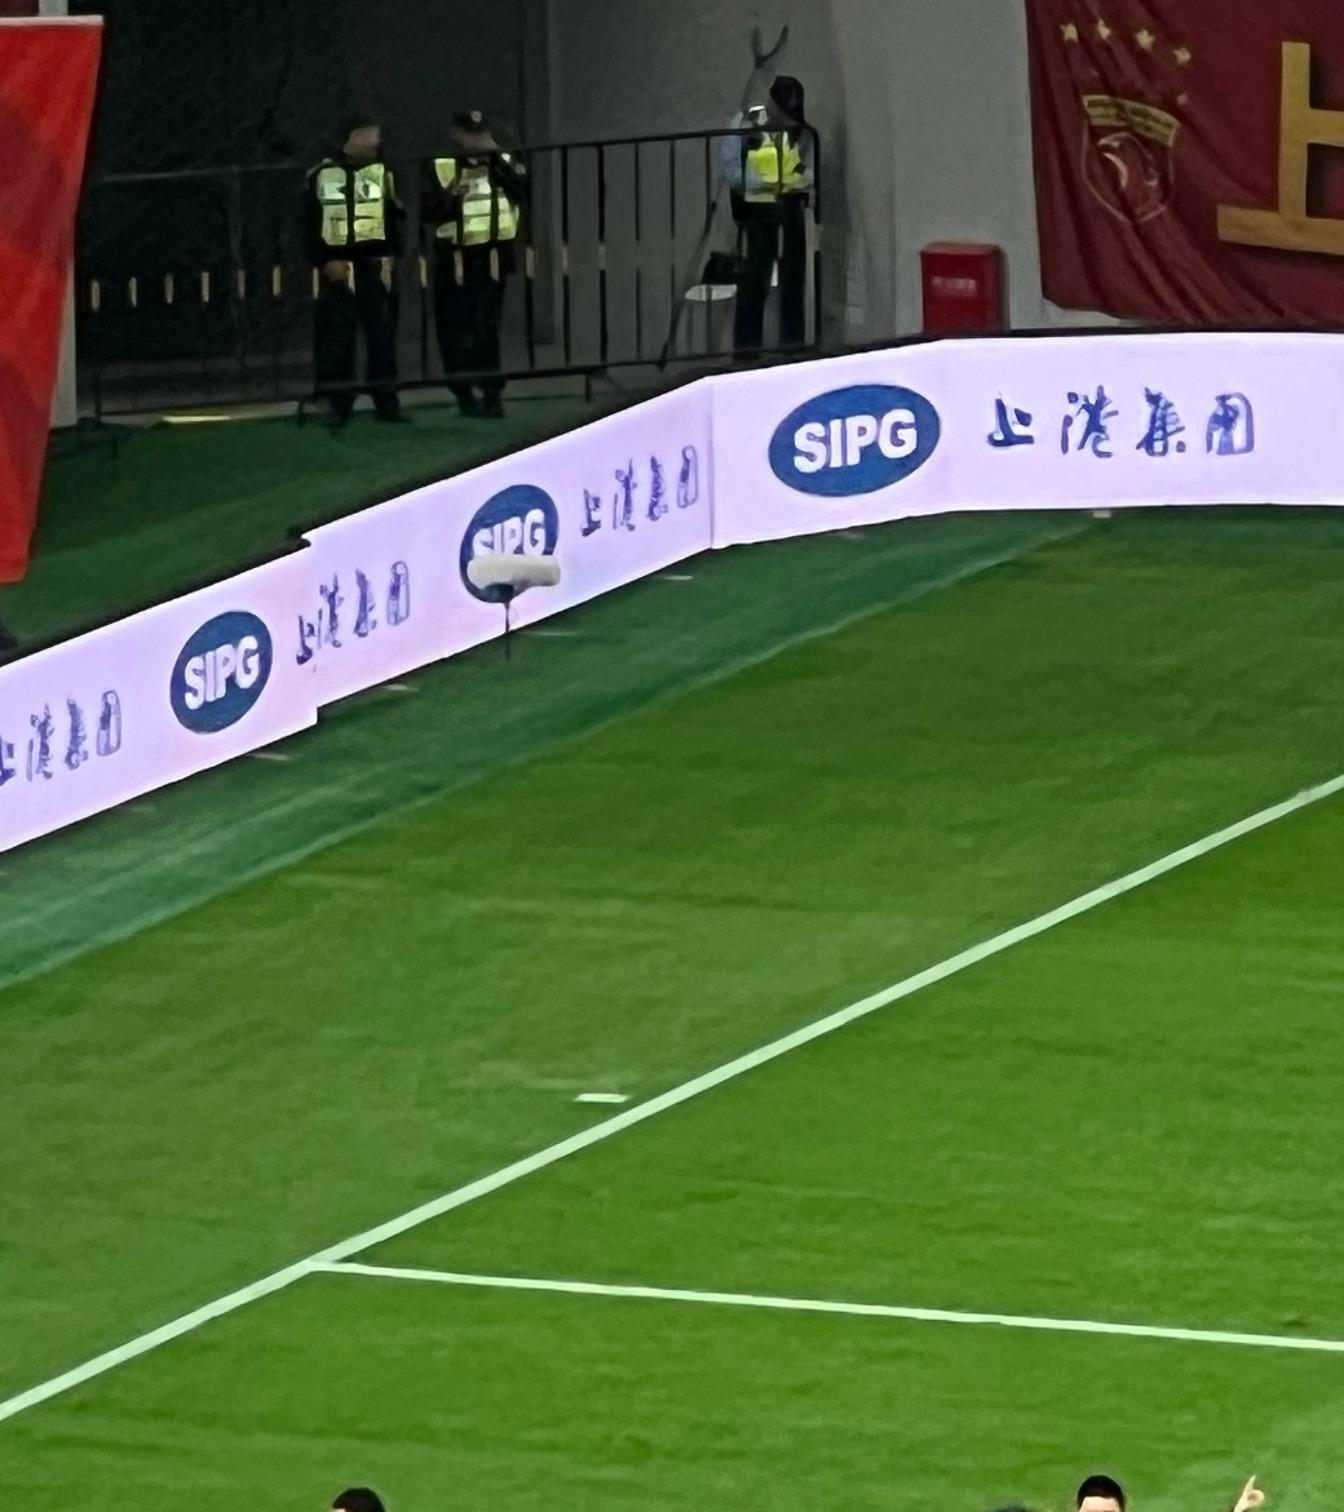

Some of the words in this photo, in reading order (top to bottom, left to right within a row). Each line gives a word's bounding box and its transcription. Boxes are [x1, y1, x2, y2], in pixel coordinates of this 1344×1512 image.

[793, 408, 918, 473] SIPG
[472, 508, 546, 556] SIPG
[184, 635, 257, 710] SIPG
